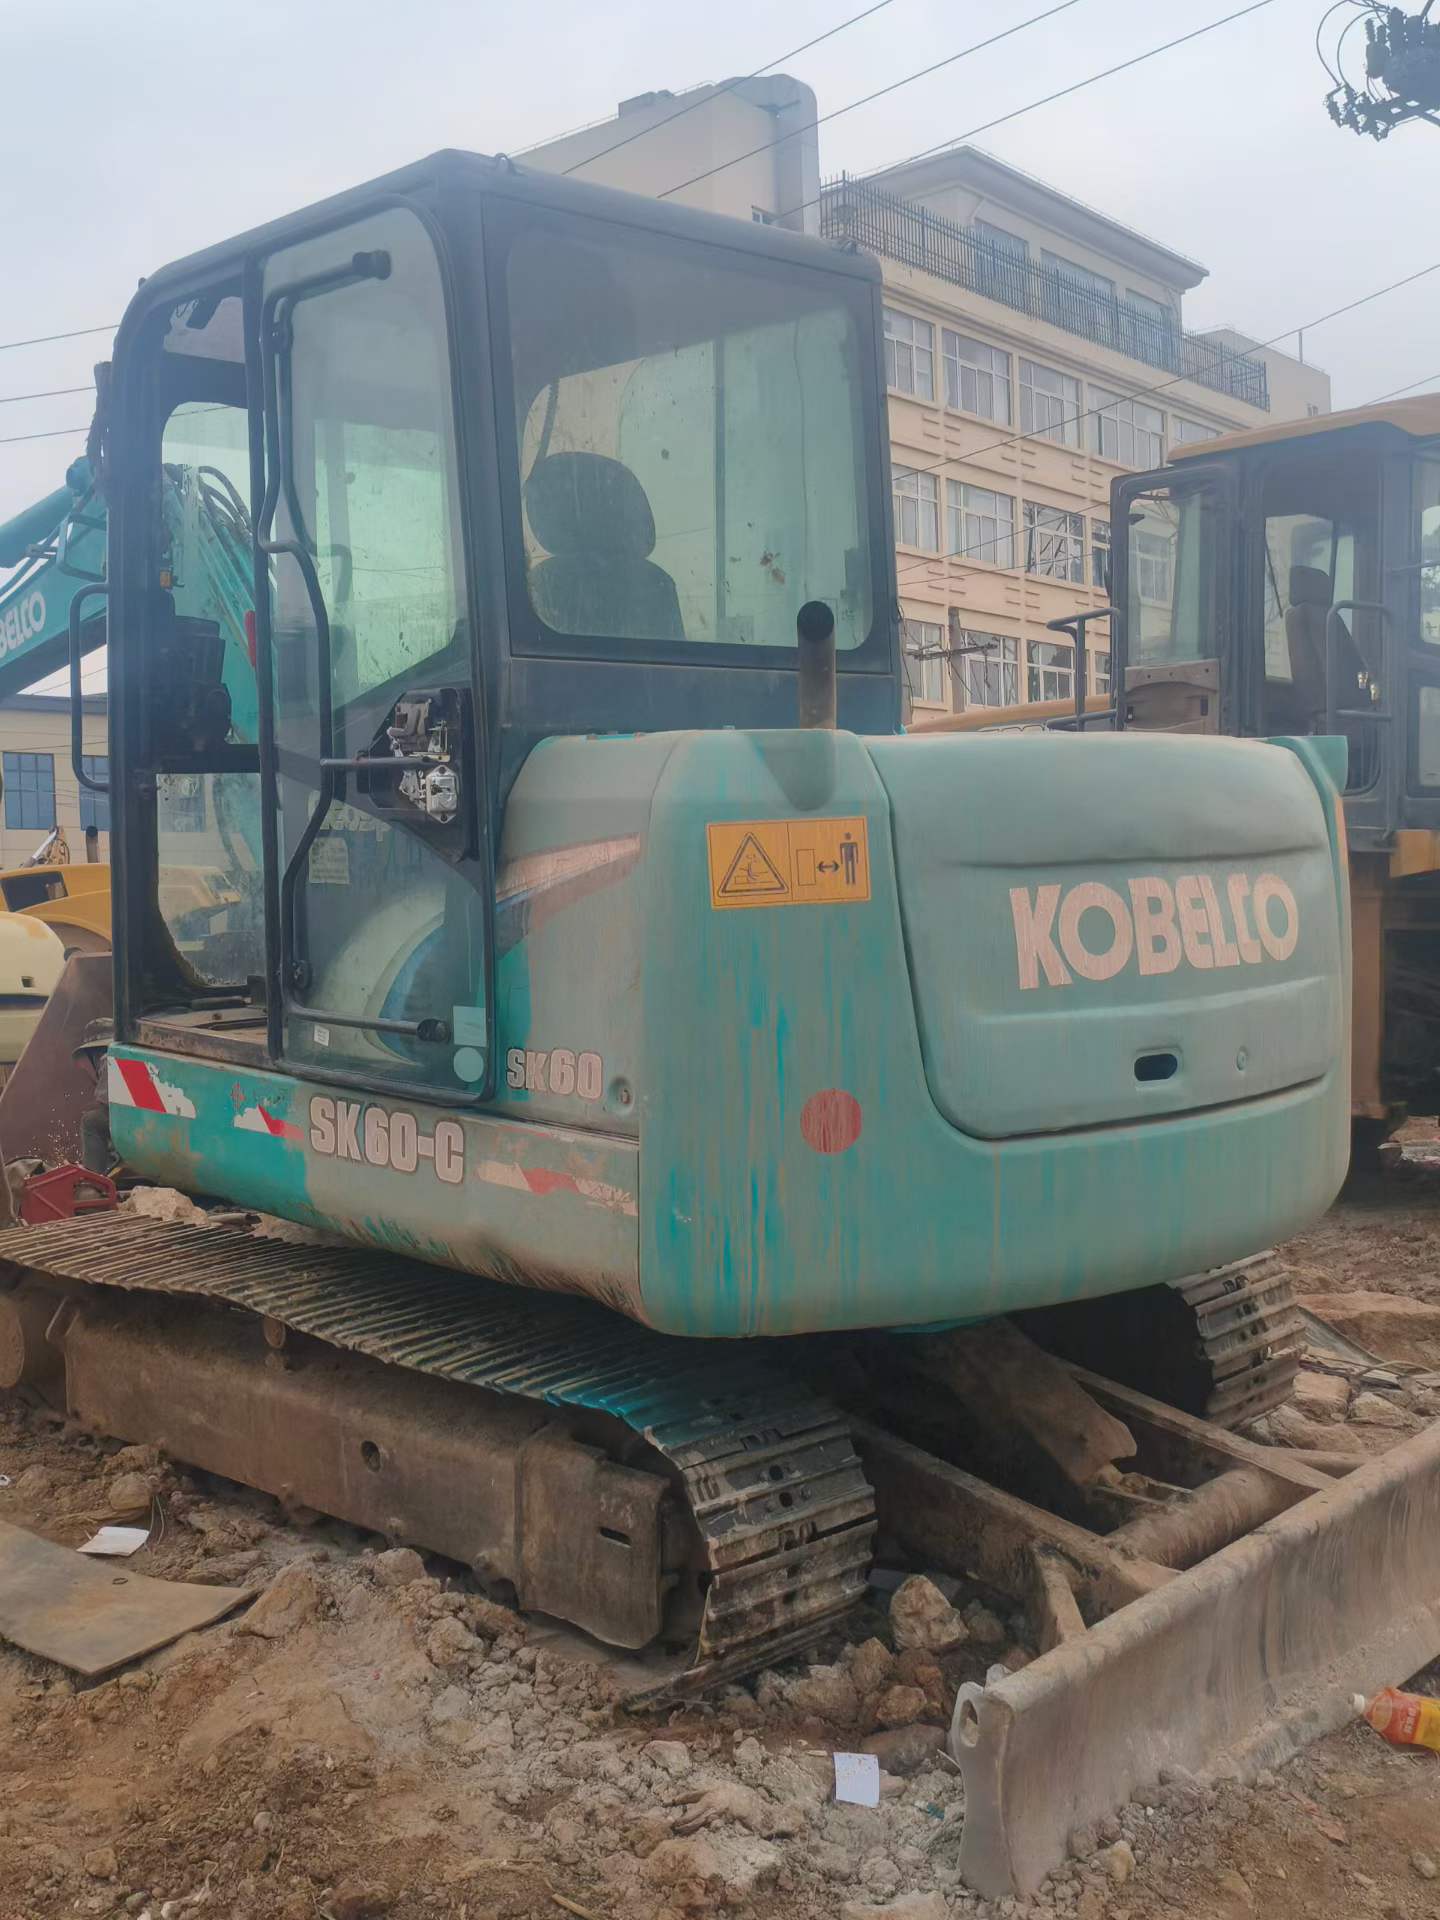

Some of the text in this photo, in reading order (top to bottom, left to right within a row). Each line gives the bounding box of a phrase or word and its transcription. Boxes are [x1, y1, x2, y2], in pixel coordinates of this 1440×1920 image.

[1009, 872, 1299, 990] KOBELCO
[506, 1047, 603, 1100] SK60
[309, 1095, 464, 1184] SK60-C
